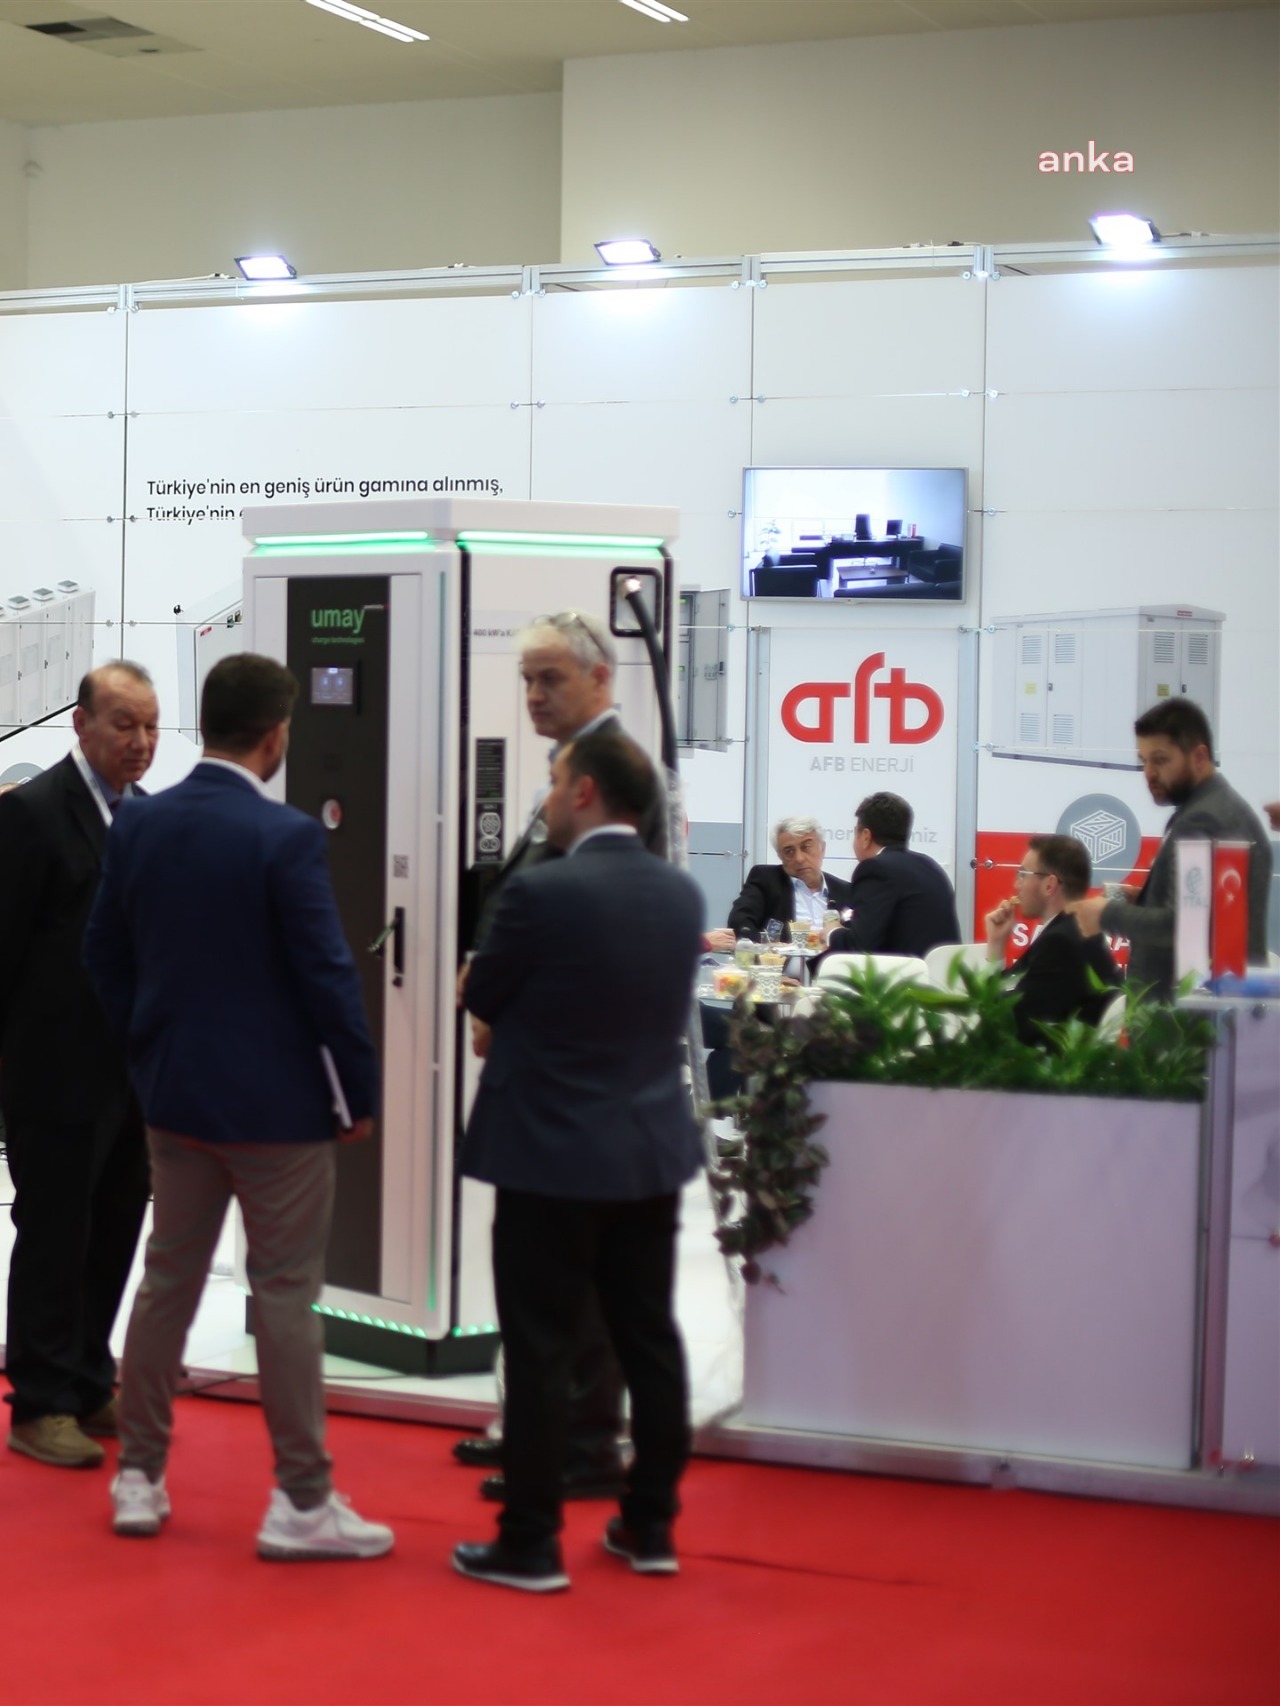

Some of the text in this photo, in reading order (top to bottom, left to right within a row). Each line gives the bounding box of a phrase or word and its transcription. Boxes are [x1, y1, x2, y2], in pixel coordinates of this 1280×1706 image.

[147, 476, 503, 500] Türkiye'nin en geniş ürün gamına alınmış,
[311, 608, 365, 634] umay
[781, 652, 945, 744] afb
[810, 755, 914, 773] AFB ENERJİ
